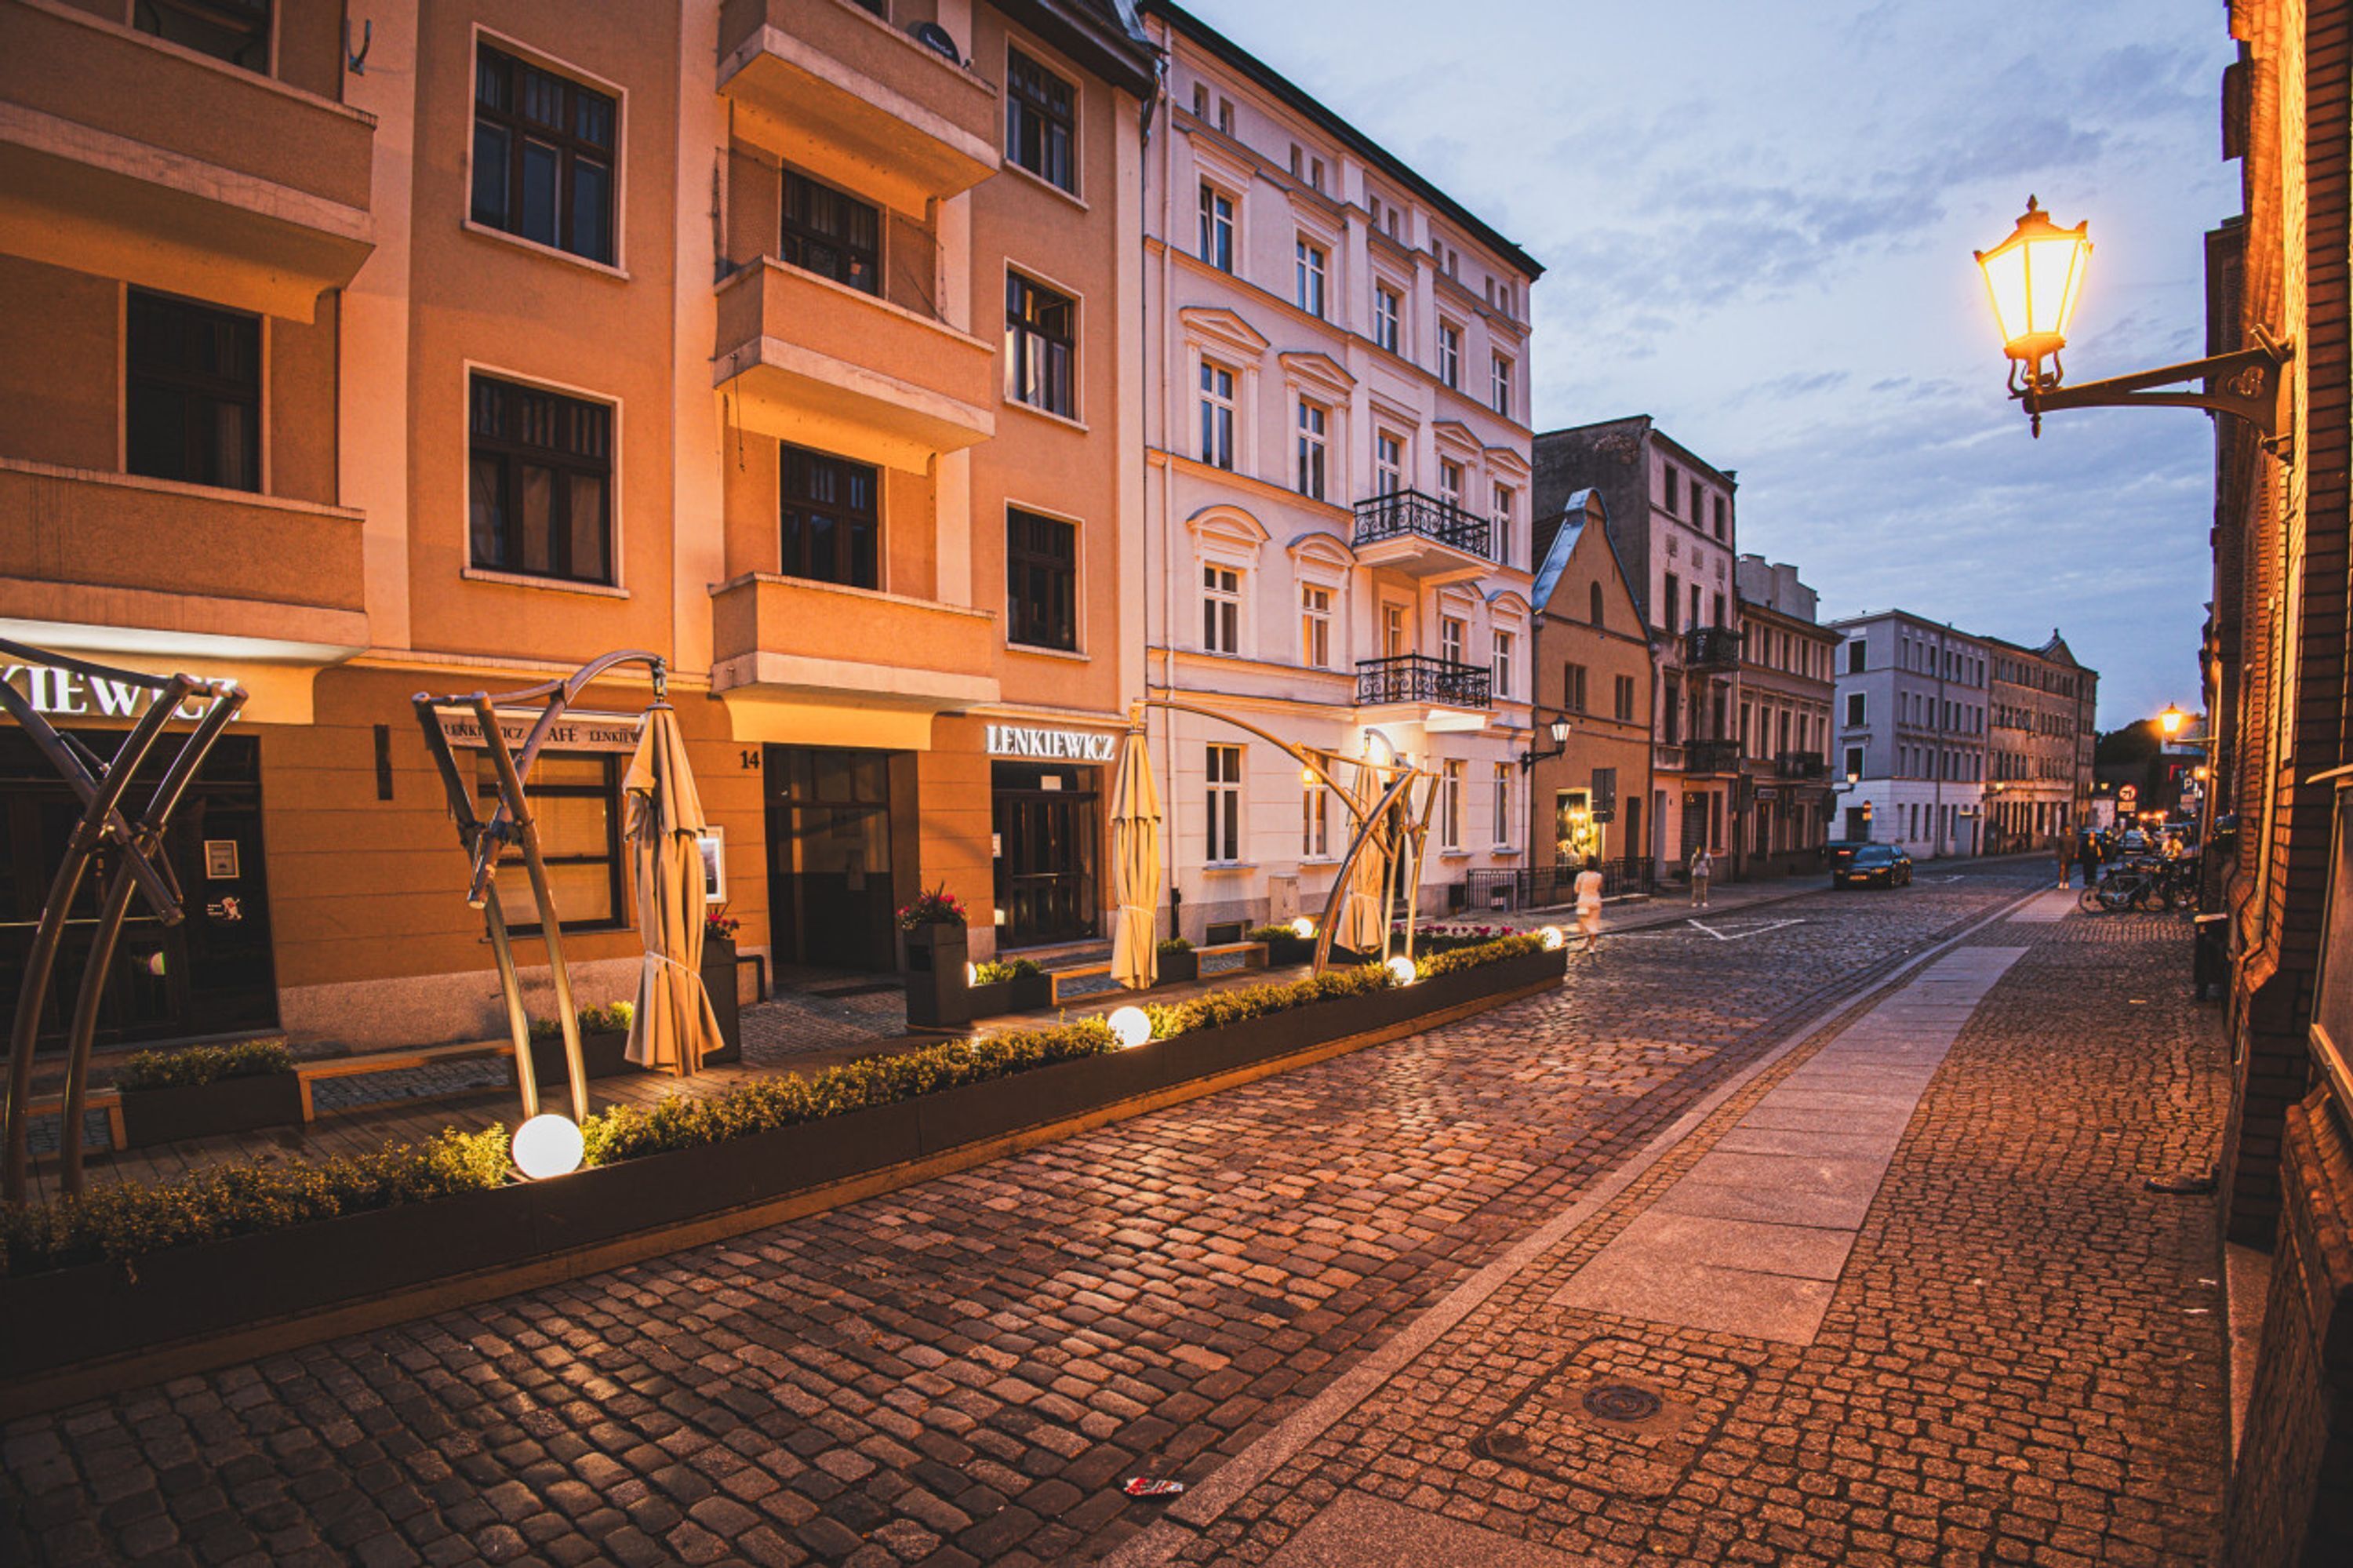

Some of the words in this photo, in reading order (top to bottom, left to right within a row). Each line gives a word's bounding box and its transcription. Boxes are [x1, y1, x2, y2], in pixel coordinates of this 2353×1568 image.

[444, 723, 524, 739] LENKIICZ
[545, 723, 578, 742] AFÉ
[986, 725, 1115, 761] LENKIEWICZ
[740, 750, 760, 769] 14
